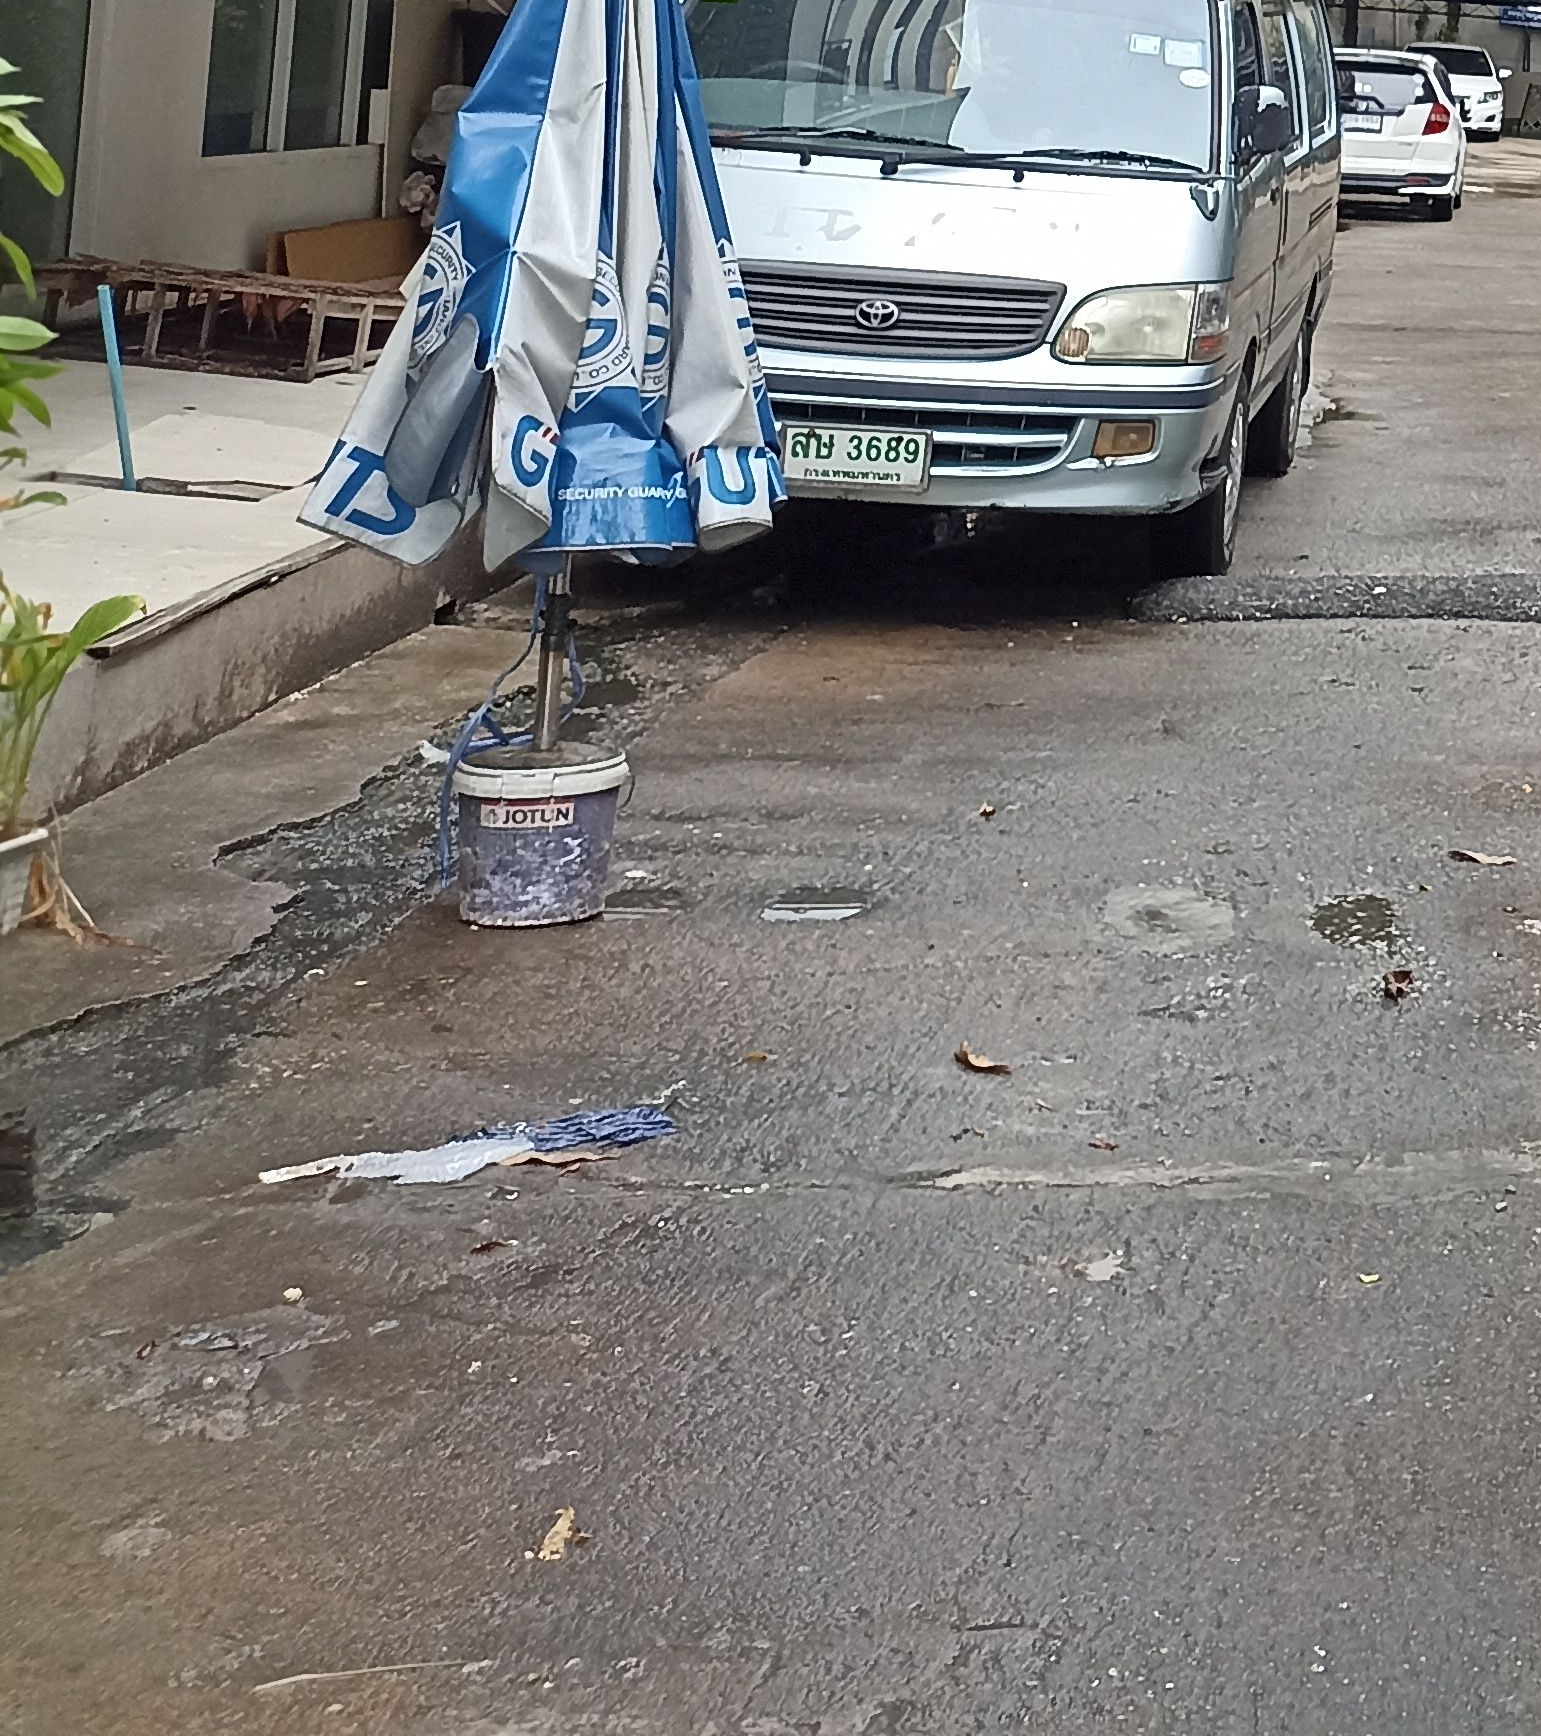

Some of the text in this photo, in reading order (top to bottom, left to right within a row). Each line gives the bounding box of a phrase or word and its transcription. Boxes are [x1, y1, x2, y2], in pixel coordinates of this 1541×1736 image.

[846, 434, 920, 464] 3689
[557, 487, 624, 501] SECURITY
[502, 806, 570, 825] JOTUN
